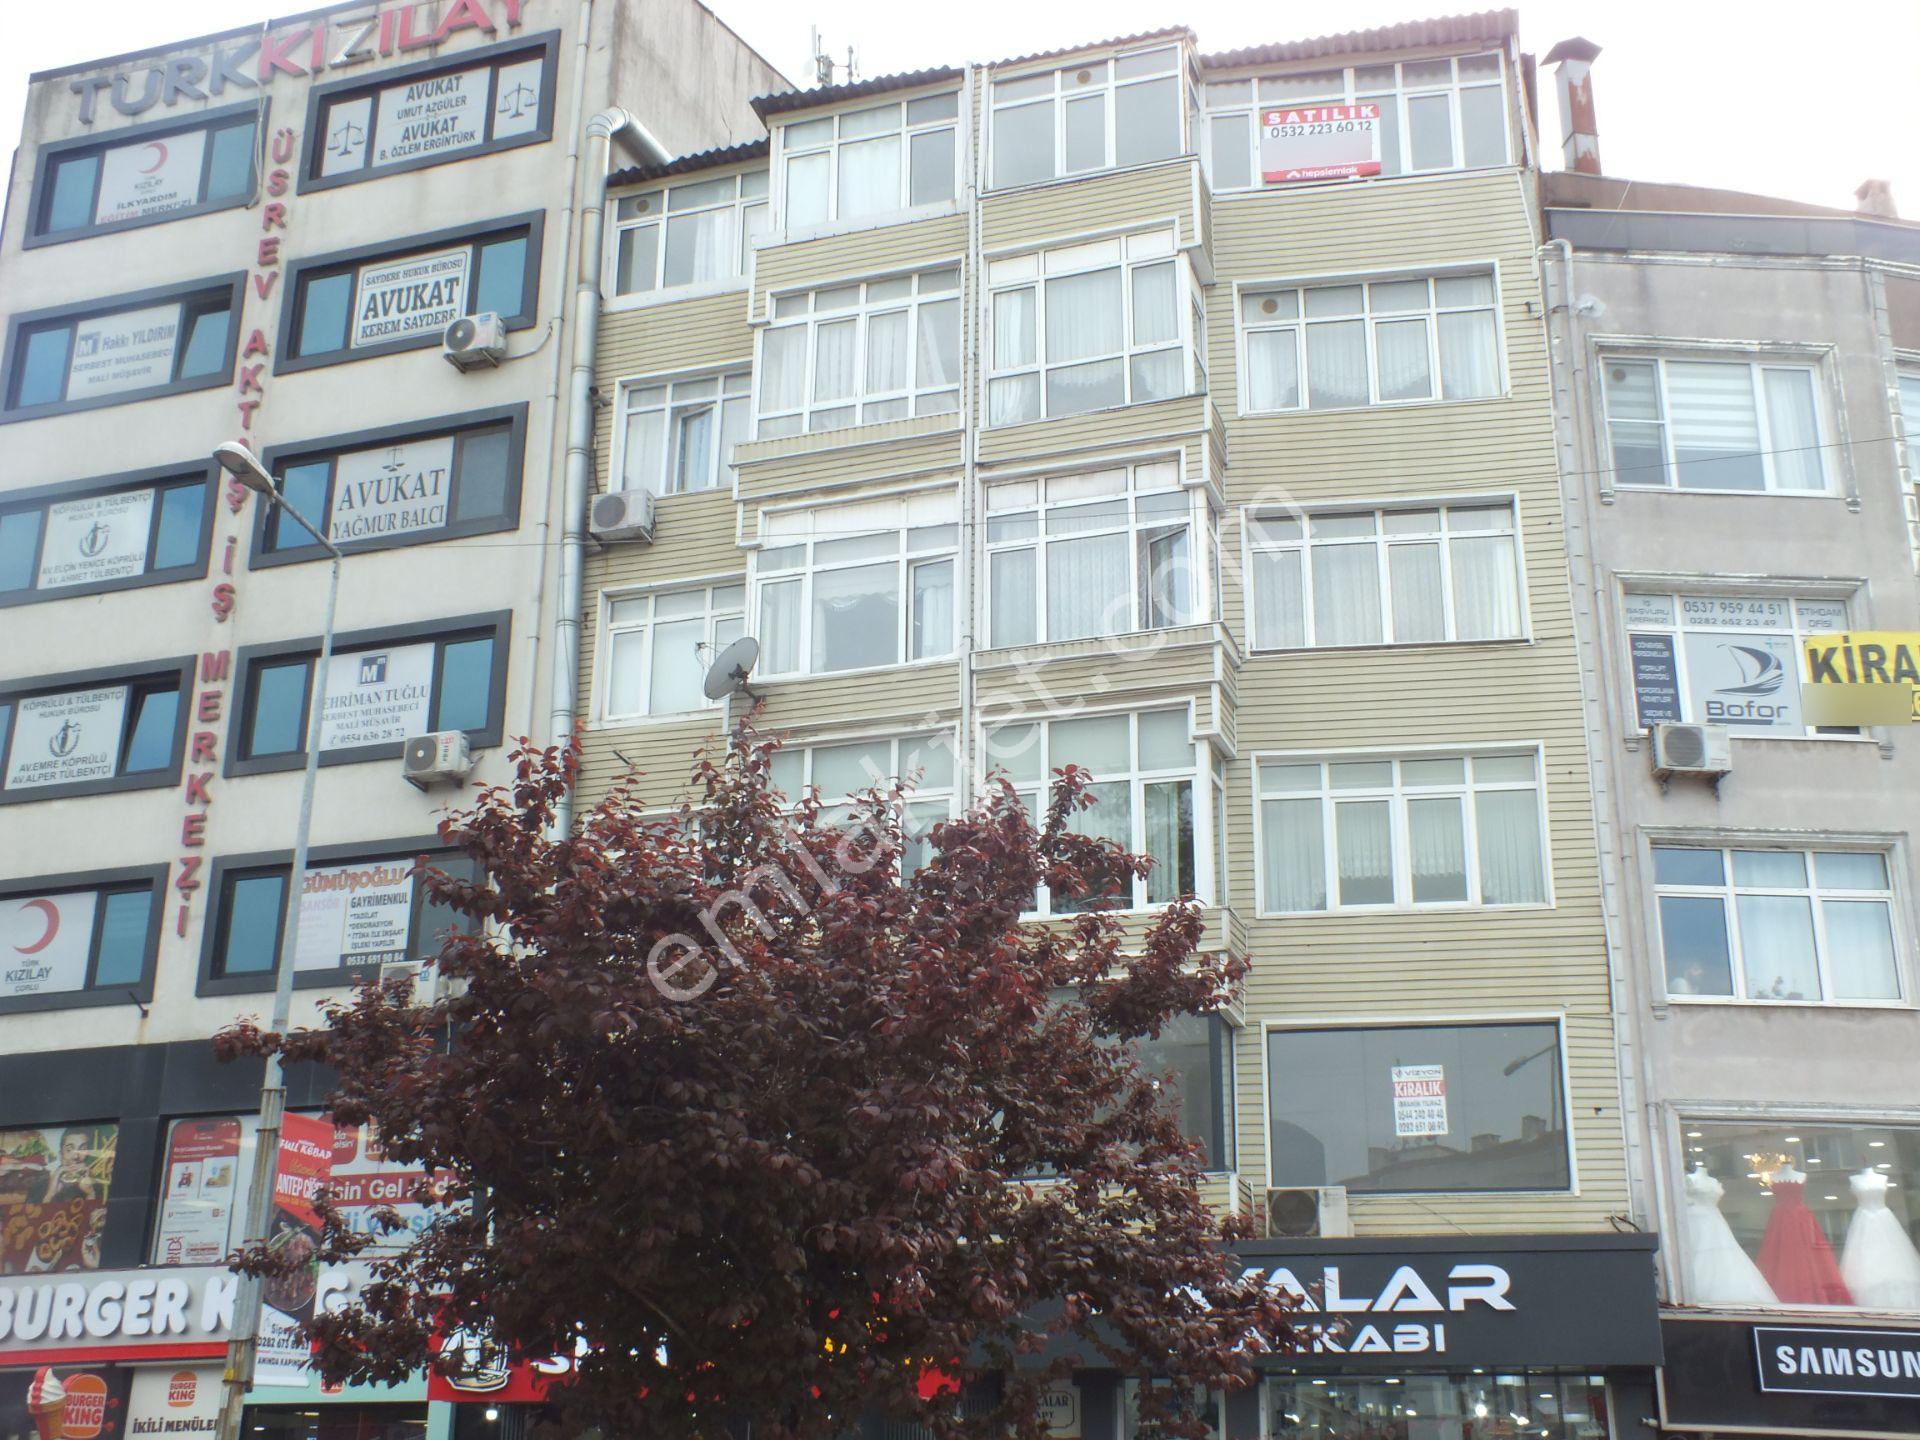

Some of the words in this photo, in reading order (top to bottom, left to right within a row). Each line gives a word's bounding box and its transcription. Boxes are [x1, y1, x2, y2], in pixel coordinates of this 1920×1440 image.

[406, 75, 463, 102] AVUKAT
[397, 105, 422, 120] UMUT
[426, 95, 467, 113] AZGÜLER
[1268, 105, 1375, 124] SATILIK
[401, 116, 458, 142] AVUKAT
[1271, 125, 1305, 138] 0532
[1309, 122, 1333, 136] 223
[1336, 120, 1354, 133] 60
[1358, 120, 1372, 131] 12
[380, 150, 388, 161] B.
[391, 142, 421, 158] ÖZLEM
[1302, 165, 1358, 178] hepsiemlak
[254, 128, 296, 301] ÜSREV
[366, 270, 401, 286] SAYDERE
[402, 264, 430, 279] HUKUK
[431, 258, 463, 274] BÜROSU
[363, 276, 460, 321] AVUKAT
[361, 320, 401, 339] KEREM
[403, 308, 457, 331] SAYDERE
[226, 328, 269, 515] AKTŞ
[338, 468, 446, 512] AVUKAT
[333, 512, 396, 540] YAĞMUR
[402, 504, 445, 529] BALCI
[211, 535, 237, 623] İŞ
[1683, 601, 1714, 613] 0537
[1720, 602, 1743, 614] 959
[1748, 604, 1764, 615] 44
[1768, 604, 1782, 616] 51
[1808, 635, 1920, 684] KİRA
[386, 683, 430, 703] TUĞLU
[1706, 700, 1790, 719] Bofor
[176, 649, 230, 937] MERKEZİ
[5, 966, 53, 983] KIZILAY
[1394, 1081, 1443, 1097] KİRALIK
[276, 1173, 303, 1196] ANTEP
[369, 1179, 403, 1199] Gel
[168, 1390, 196, 1401] KING
[169, 1382, 197, 1391] BURGER
[66, 1394, 105, 1407] BURGER
[63, 1407, 103, 1425] KING
[132, 1417, 163, 1434] İKİLİ
